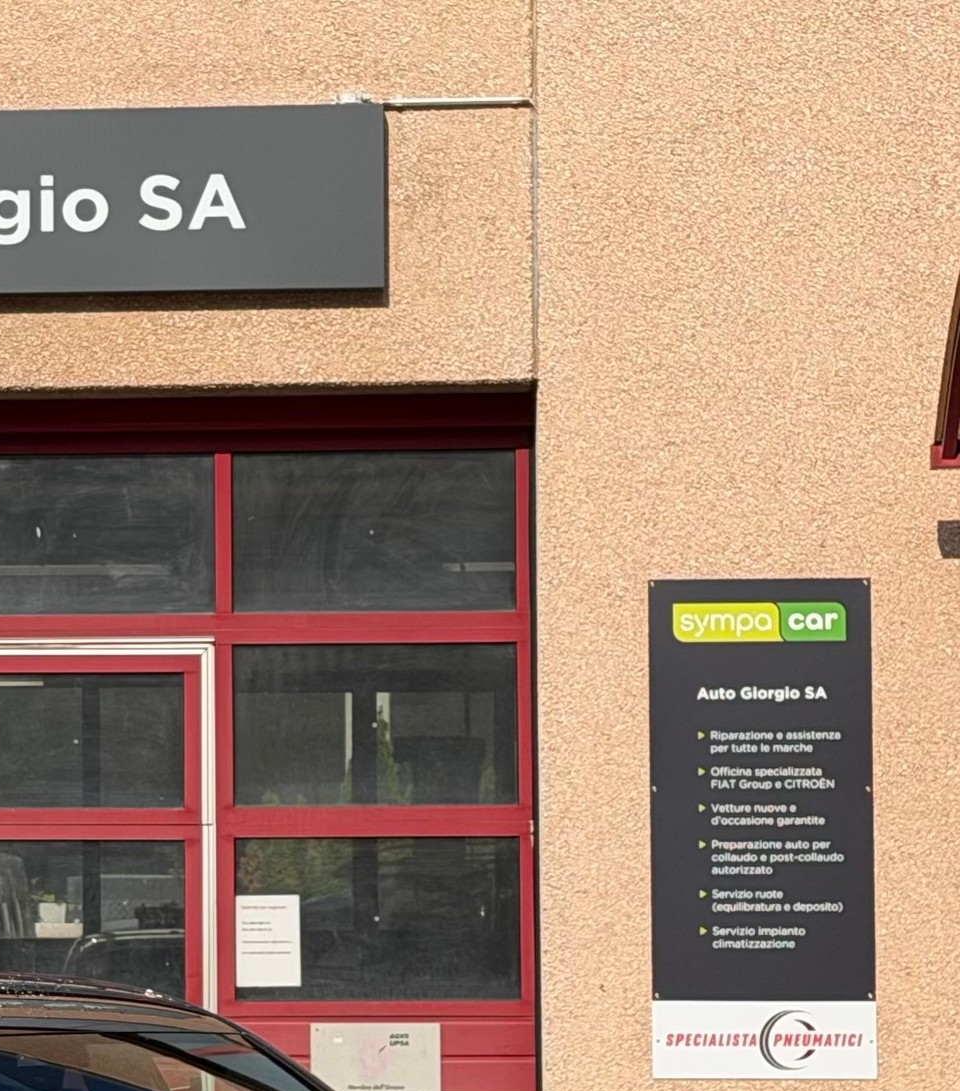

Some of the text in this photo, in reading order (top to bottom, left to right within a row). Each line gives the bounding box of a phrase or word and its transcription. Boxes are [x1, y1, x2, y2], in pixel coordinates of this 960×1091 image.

[139, 174, 246, 231] SA
[680, 612, 838, 637] sympa car
[697, 686, 827, 702] Auto Giorgio SA
[710, 731, 841, 741] Riparazione e assistenza
[710, 743, 813, 754] per tutte le marche
[711, 767, 822, 778] Officina specializzata
[711, 779, 736, 789] FIAT
[739, 779, 772, 789] Group
[775, 781, 782, 789] e
[711, 804, 751, 813] Vetture
[754, 805, 787, 813] nuove
[711, 816, 825, 827] d'occasione garantite
[712, 839, 831, 851] Preparazione auto per
[711, 852, 844, 863] collaudo e post-collaudo
[712, 866, 773, 874] autorizzato
[712, 889, 783, 899] Servizio ruote
[712, 902, 781, 912] (equilibratura
[793, 902, 843, 912] deposito)
[713, 926, 806, 937] Servizio impianto
[712, 939, 795, 949] climatizzazione
[666, 1034, 863, 1047] SPECIALISTA PNEUMATICI
